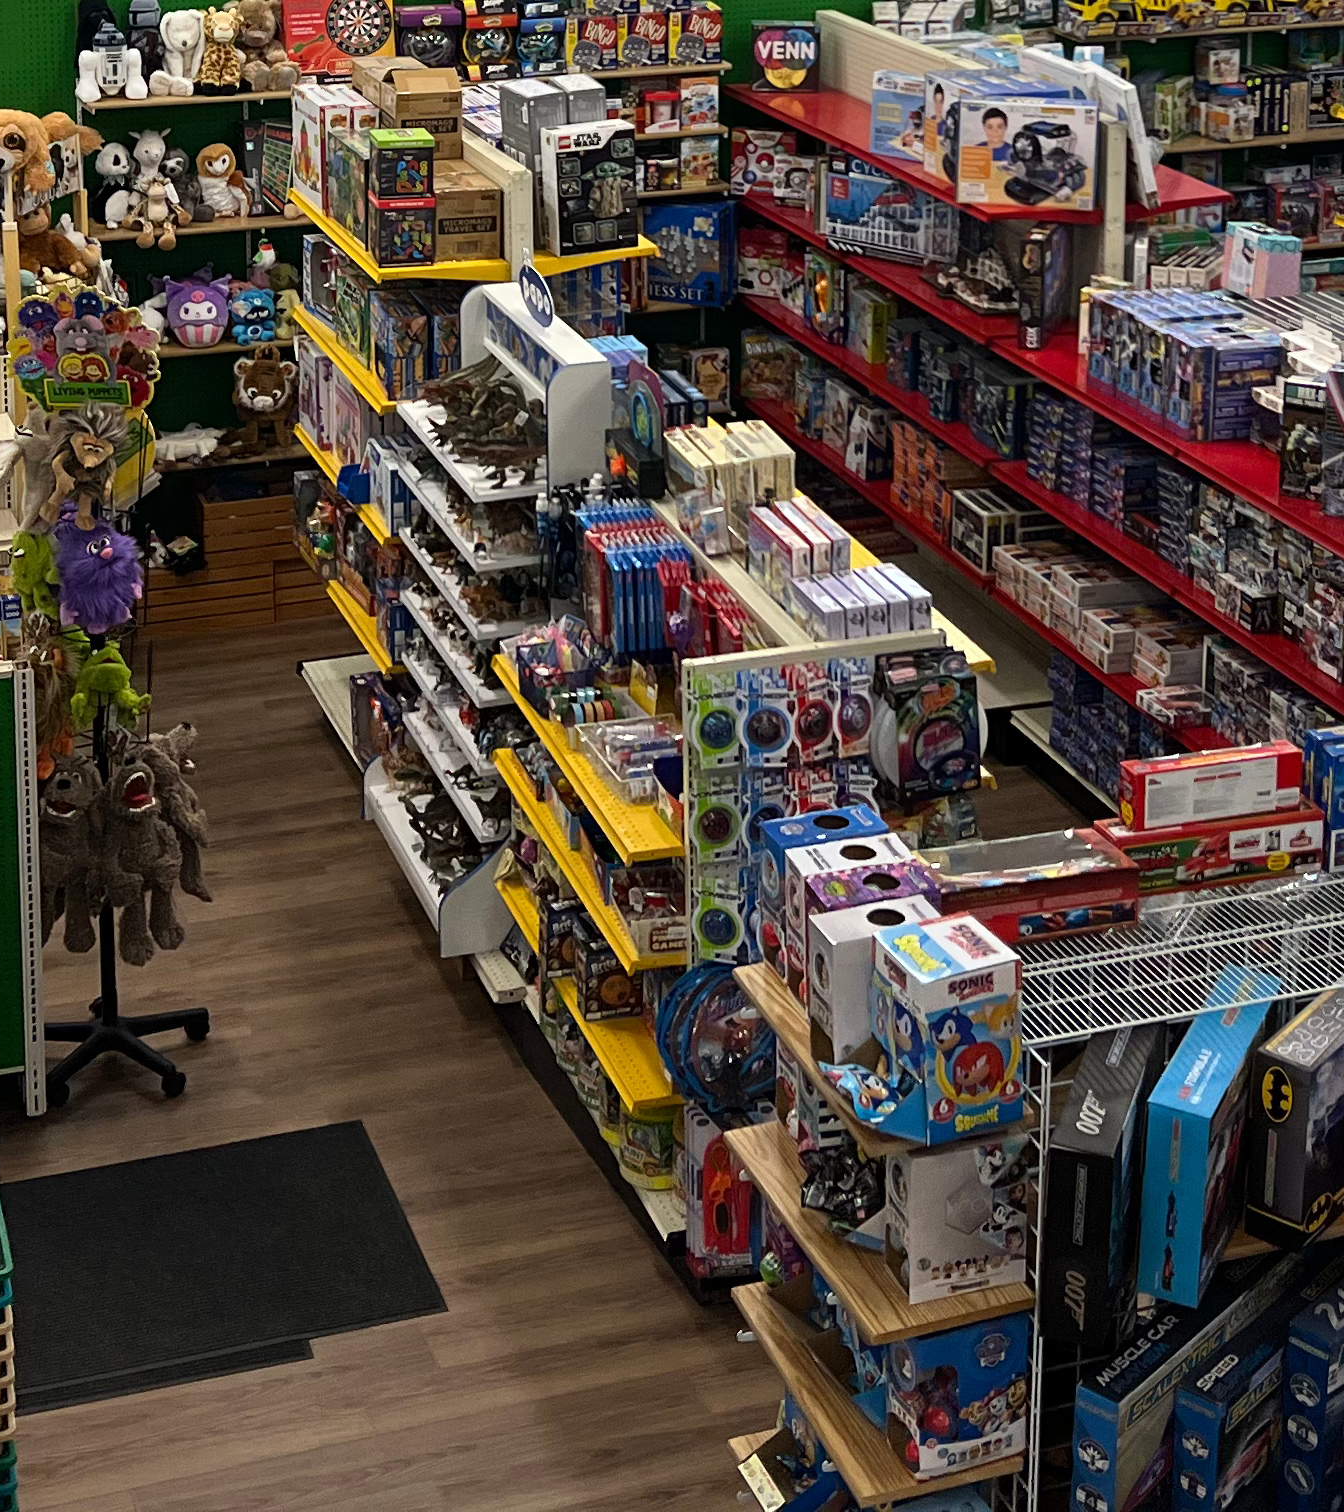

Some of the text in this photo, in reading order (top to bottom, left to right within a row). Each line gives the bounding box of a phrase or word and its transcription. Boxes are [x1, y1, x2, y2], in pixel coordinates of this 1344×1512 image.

[584, 20, 616, 46] BINGO
[635, 14, 667, 41] BINGO
[689, 14, 722, 40] BINGO
[757, 39, 815, 61] VENN
[406, 119, 454, 127] MICROMAGS
[573, 138, 602, 148] WARS
[576, 132, 600, 141] STAR
[443, 218, 493, 227] MICROMAGS
[443, 223, 493, 234] TRAVEL SET
[522, 274, 551, 317] papo
[679, 286, 704, 301] SET
[52, 385, 124, 399] LIVING PUPPETS
[947, 972, 994, 995] SONIC
[1006, 1081, 1014, 1094] 6
[940, 1100, 947, 1114] 6
[1076, 1089, 1106, 1136] 007
[1064, 1270, 1087, 1331] 007
[1095, 1315, 1180, 1388] MUSCLE CAR
[1129, 1322, 1226, 1421] SCALEXTRIC
[1195, 1353, 1240, 1393] SPEED
[1231, 1368, 1280, 1425] SCALEX
